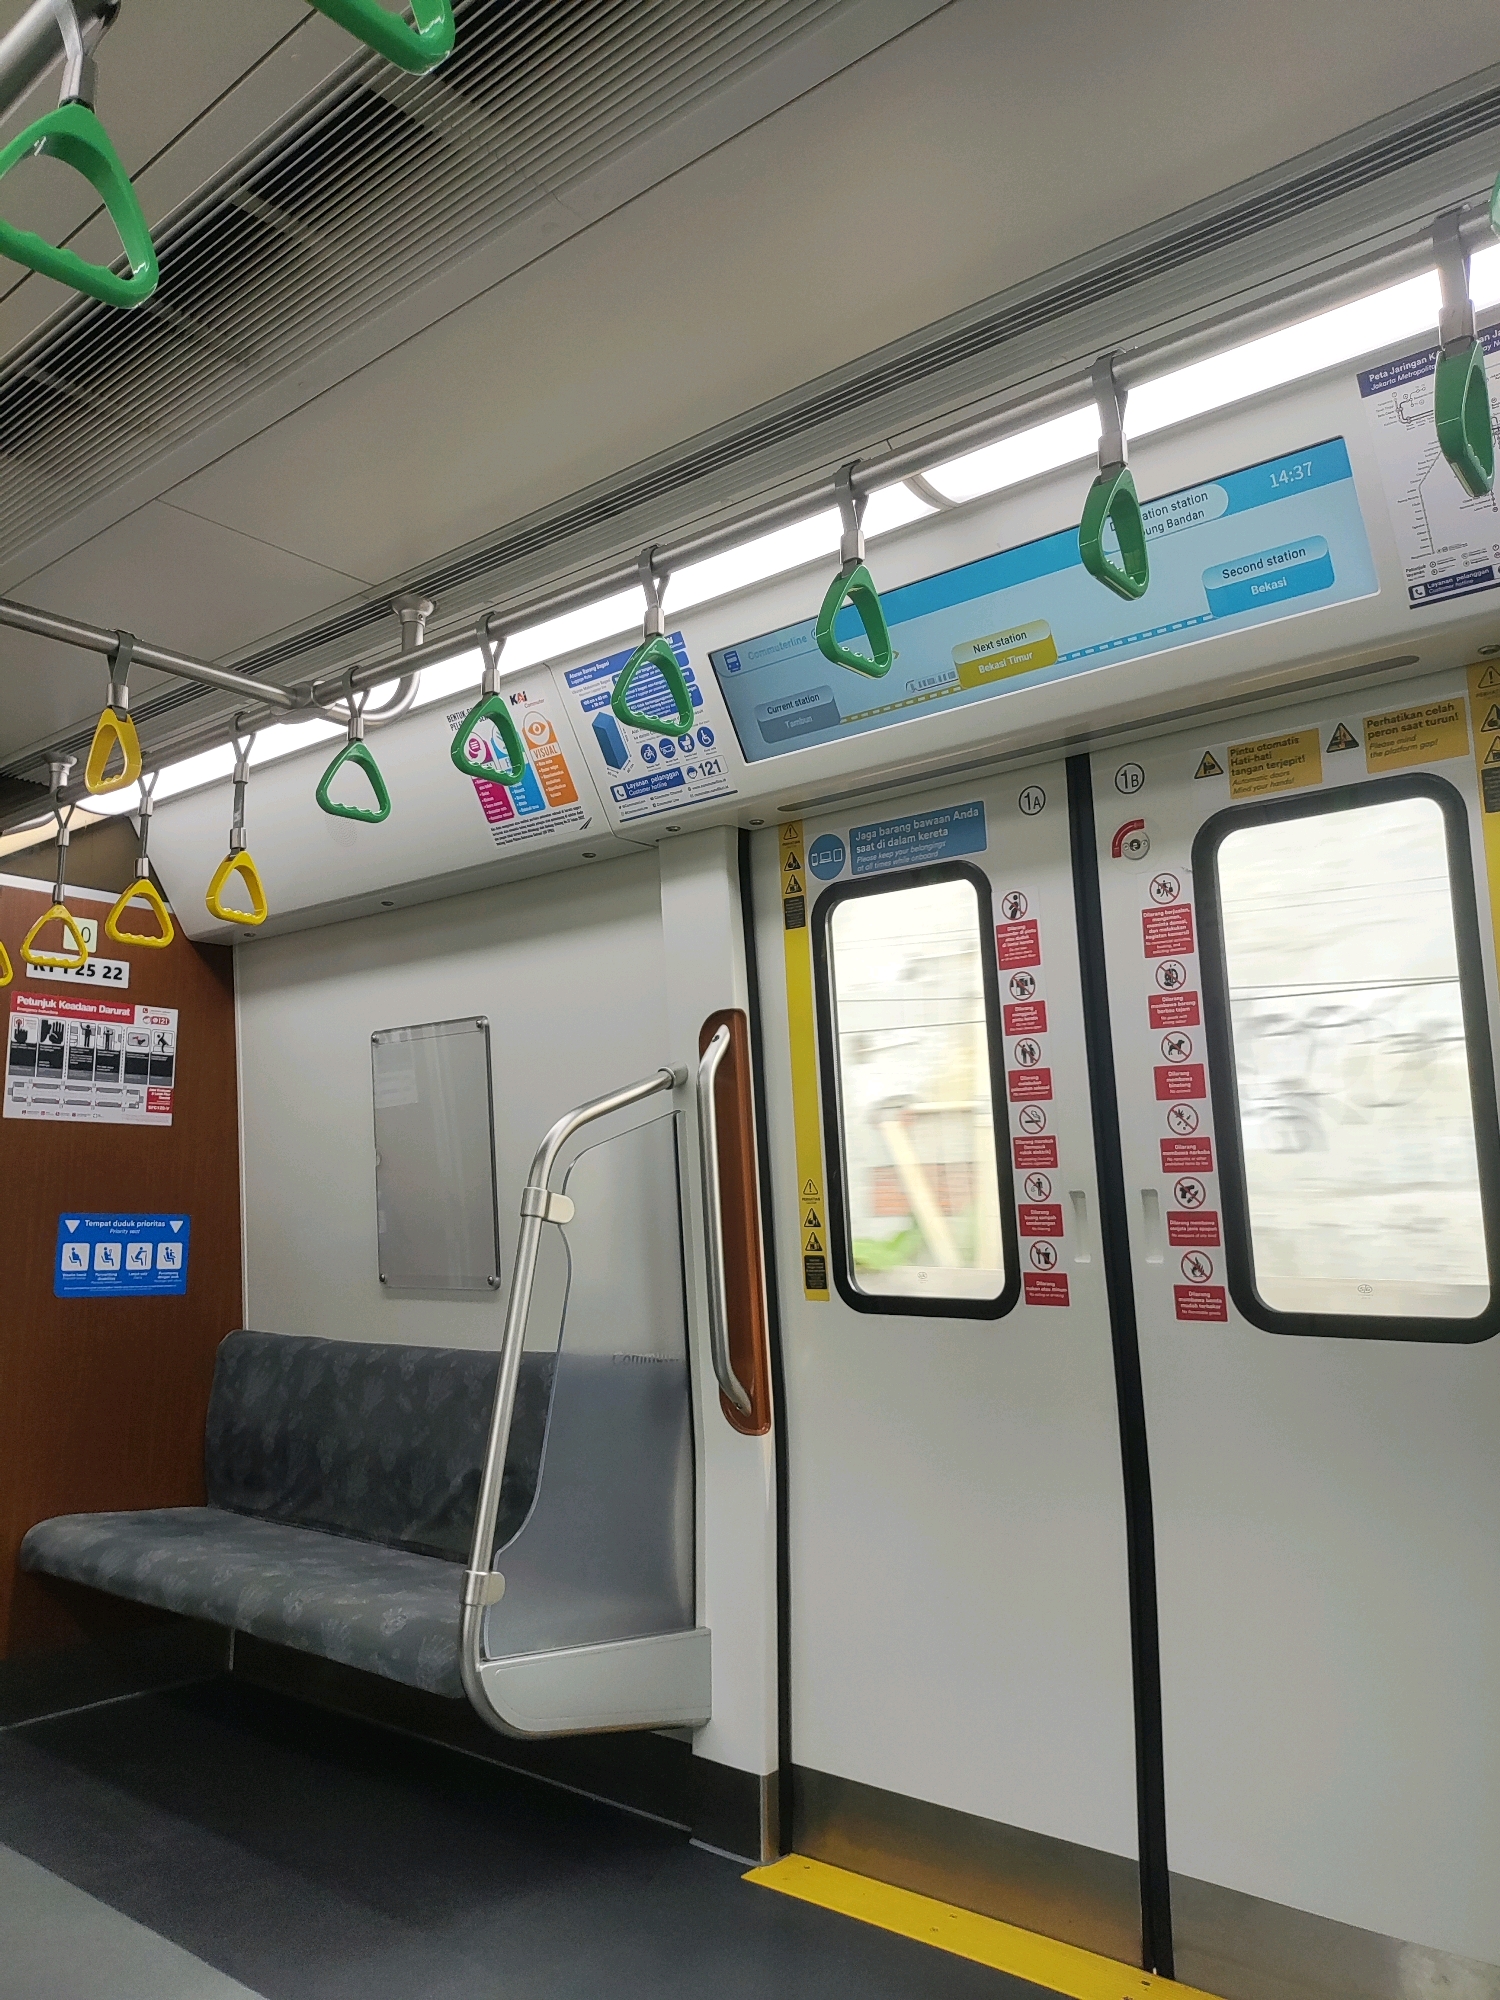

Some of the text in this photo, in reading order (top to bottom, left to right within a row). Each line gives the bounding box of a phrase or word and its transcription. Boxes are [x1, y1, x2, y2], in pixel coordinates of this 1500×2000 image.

[1368, 357, 1427, 382] Peta Jaringan
[1371, 364, 1436, 391] Jakarta Metropolita
[1269, 461, 1313, 489] 14:37
[1171, 491, 1209, 512] station
[1167, 509, 1205, 530] Bandan
[1222, 547, 1307, 580] Second station
[1250, 577, 1287, 595] Bekasi
[1427, 578, 1454, 589] Layanan
[1456, 568, 1490, 582] pelanggan
[747, 633, 808, 661] Commuterline
[973, 631, 1028, 654] Next station
[978, 652, 1034, 674] Bekasi Timur
[767, 693, 820, 715] Current station
[785, 715, 813, 729] Tambun
[1367, 703, 1455, 728] Perhatikan celah
[1368, 712, 1459, 740] peron saat turun!
[1230, 736, 1300, 757] Pintu otomatis
[1370, 734, 1417, 750] Please mind
[1370, 739, 1439, 759] the platform gap!
[533, 747, 558, 760] VISUAL
[1231, 751, 1272, 767] Hati-hati
[625, 779, 649, 790] Layanan
[650, 770, 681, 783] pelanggan
[698, 759, 722, 777] 121
[1231, 754, 1306, 777] tangan terjepit!
[1269, 770, 1290, 779] doors
[1121, 770, 1140, 789] 1B
[1233, 777, 1295, 795] Mind your hands!
[628, 786, 651, 797] Customer
[1024, 792, 1041, 811] 1A
[855, 807, 979, 842] Jaga barang bawaan Anda
[856, 827, 949, 854] saat di dalam kereta
[856, 840, 947, 864] Please keep your belongings
[874, 859, 892, 869] times
[892, 855, 910, 867] while
[911, 851, 939, 863] onboard
[102, 965, 123, 981] 22
[17, 995, 57, 1009] Petunjuk
[58, 1000, 97, 1013] Keadaan
[98, 1004, 131, 1017] Darurat
[85, 1219, 166, 1228] Tempat duduk prioritas
